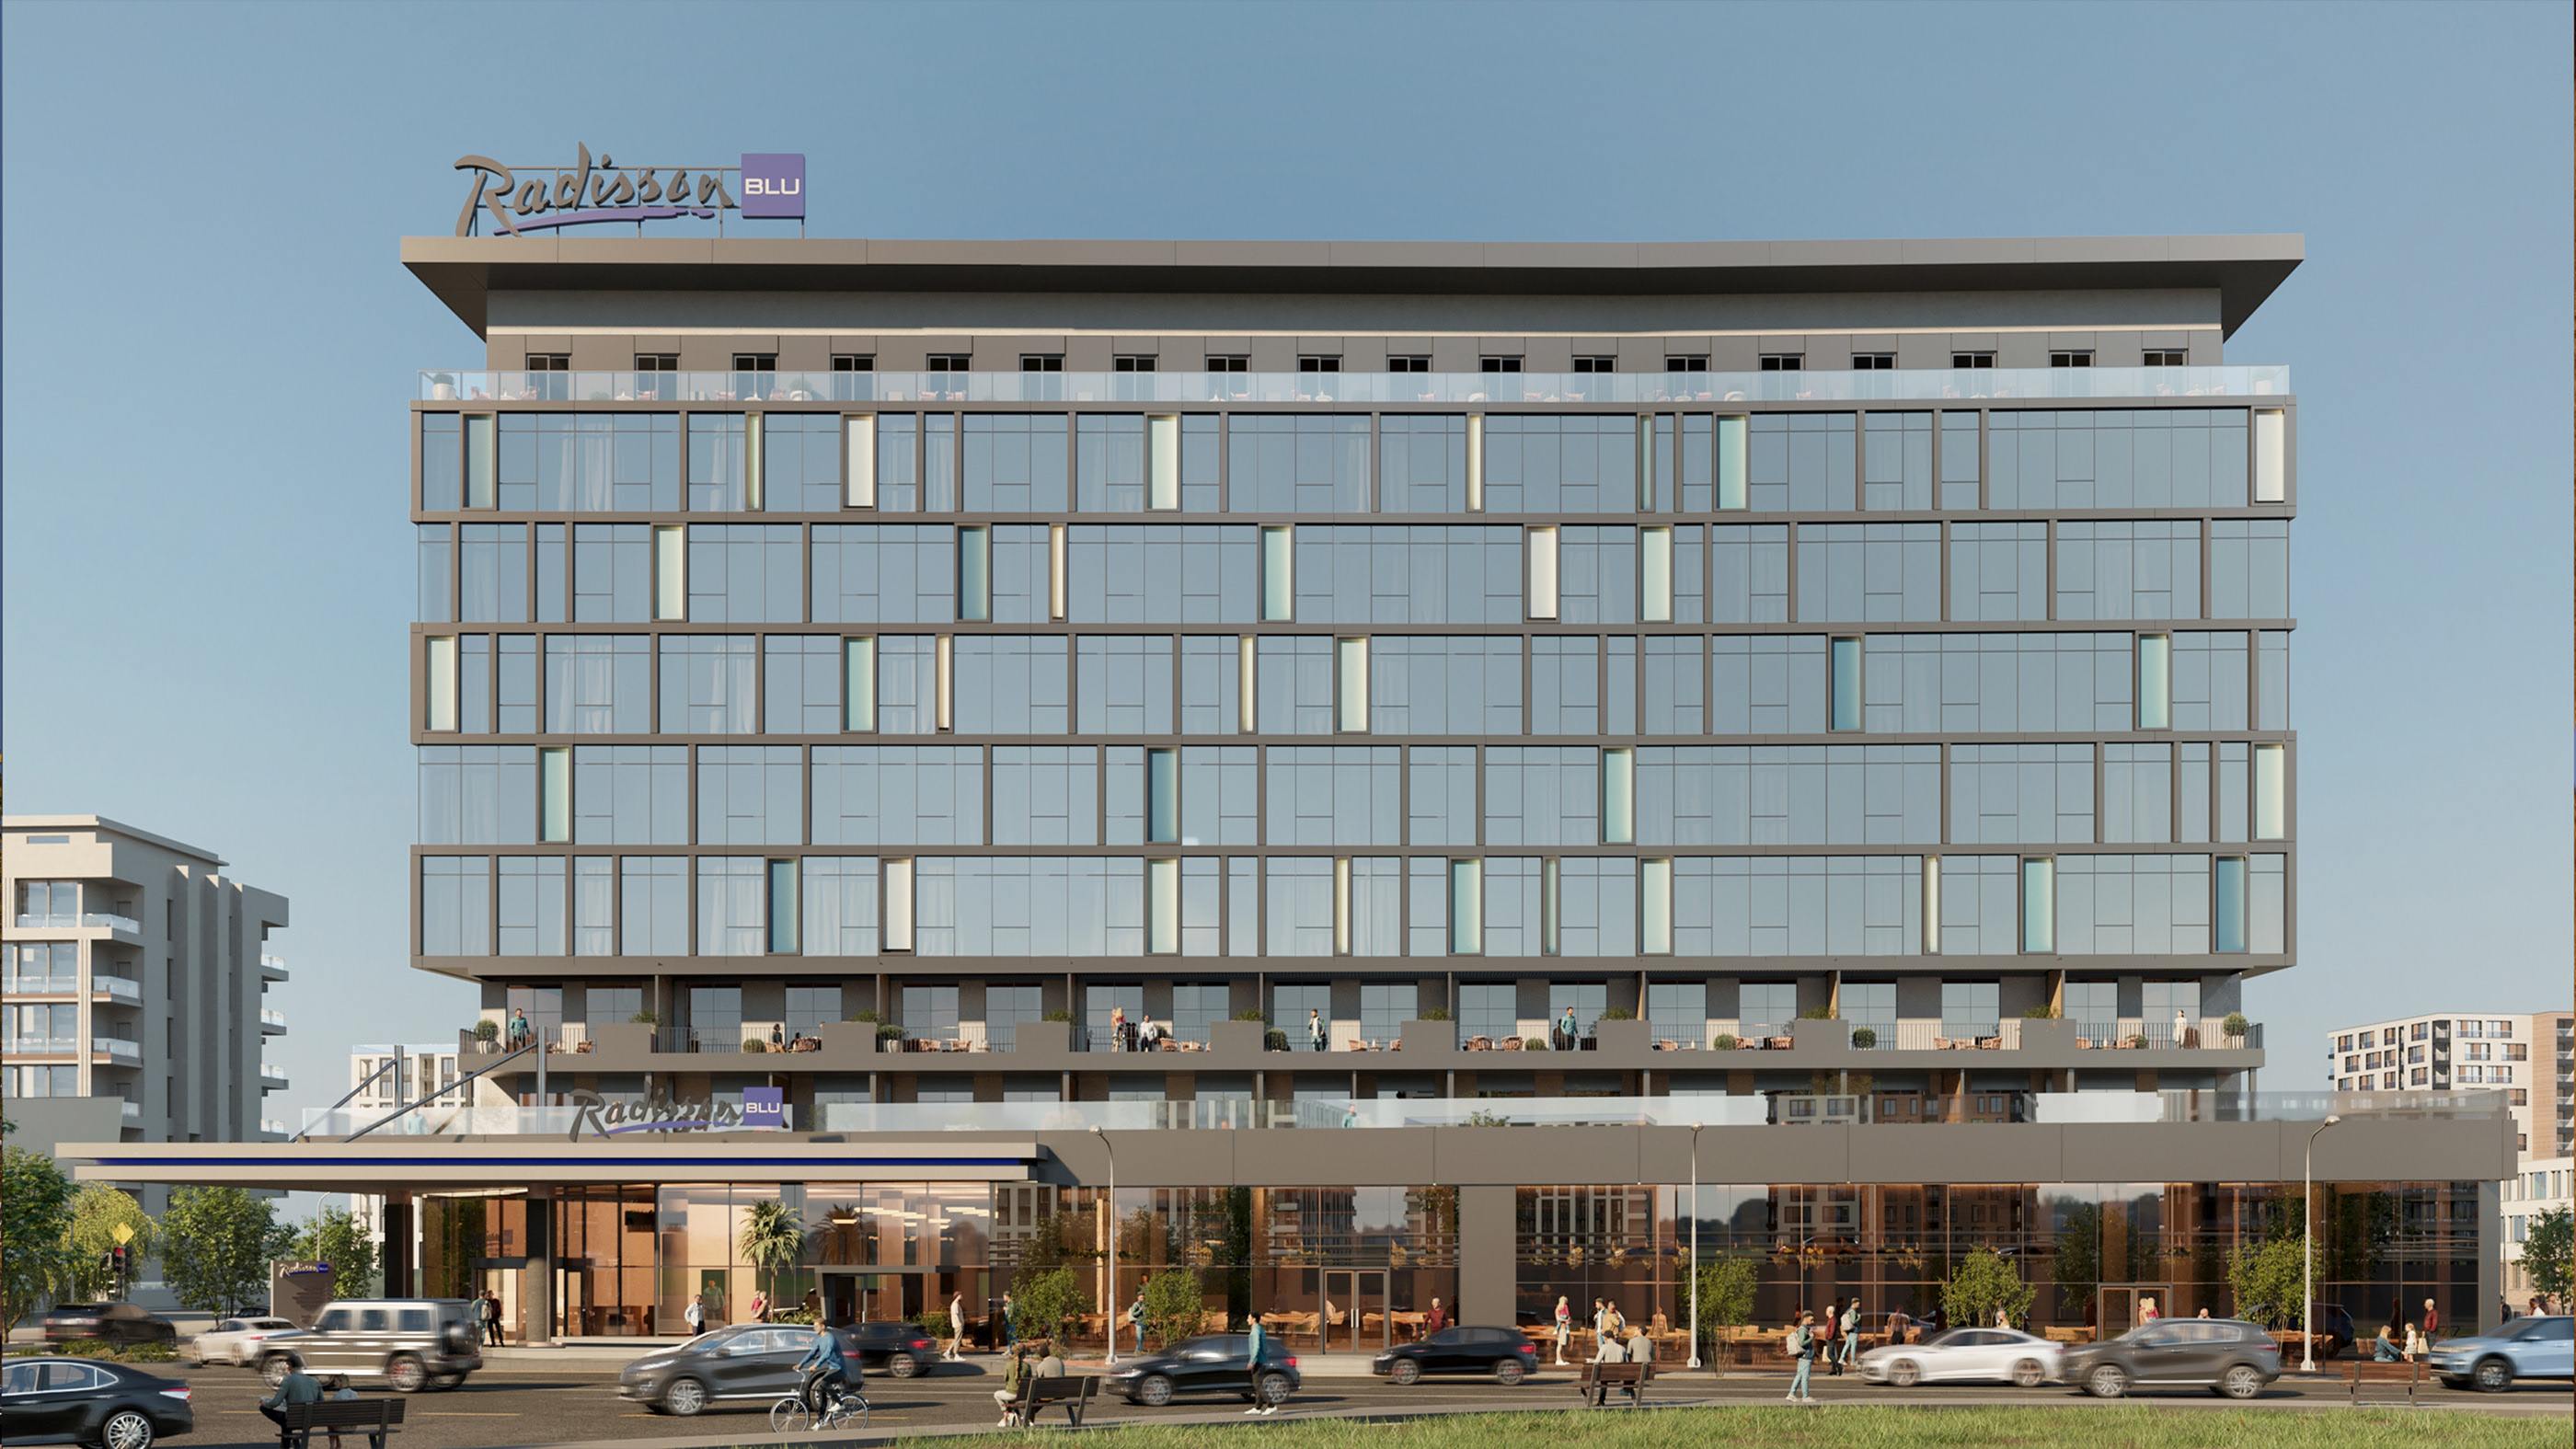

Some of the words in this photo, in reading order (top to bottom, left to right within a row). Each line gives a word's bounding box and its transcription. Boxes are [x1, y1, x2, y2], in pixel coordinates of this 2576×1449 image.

[454, 141, 735, 237] Radisson
[745, 178, 800, 195] BLU
[569, 1079, 742, 1143] Radisson
[745, 1102, 780, 1114] BLU
